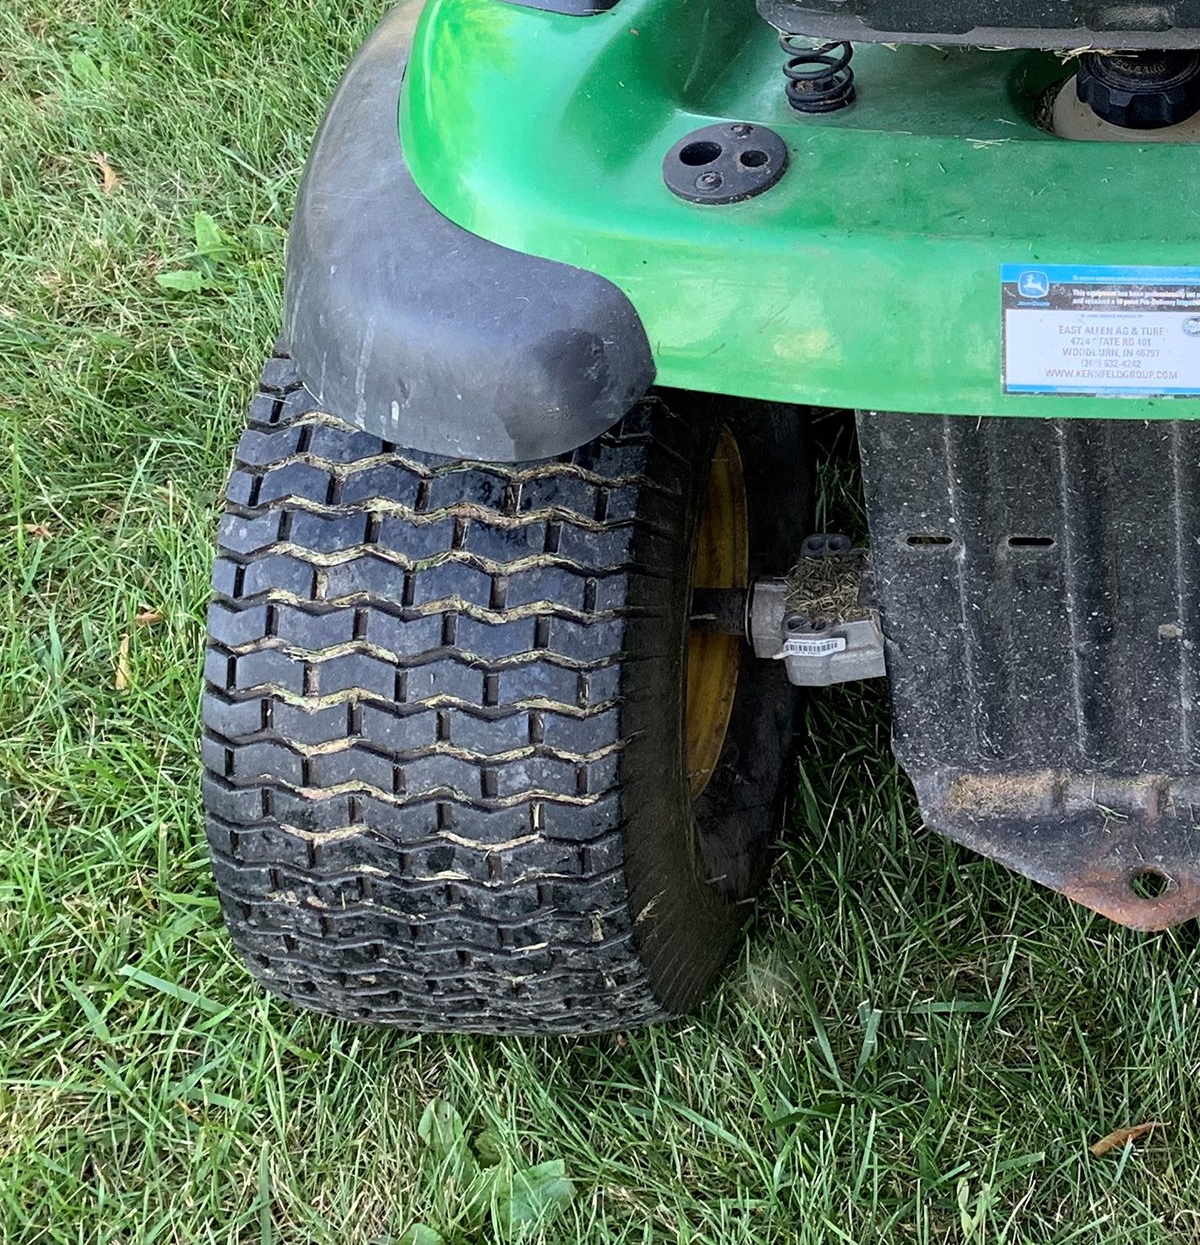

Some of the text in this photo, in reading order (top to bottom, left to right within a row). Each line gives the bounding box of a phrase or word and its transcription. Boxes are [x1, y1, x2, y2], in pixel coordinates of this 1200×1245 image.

[1058, 325, 1082, 335] EAST
[1115, 326, 1129, 336] AG
[1131, 326, 1139, 336] &
[1141, 327, 1165, 336] TURF
[1092, 337, 1120, 347] TATE
[1122, 338, 1135, 347] RD
[1137, 338, 1151, 347] 101
[1123, 348, 1134, 357] IN
[1080, 359, 1102, 368] (26)
